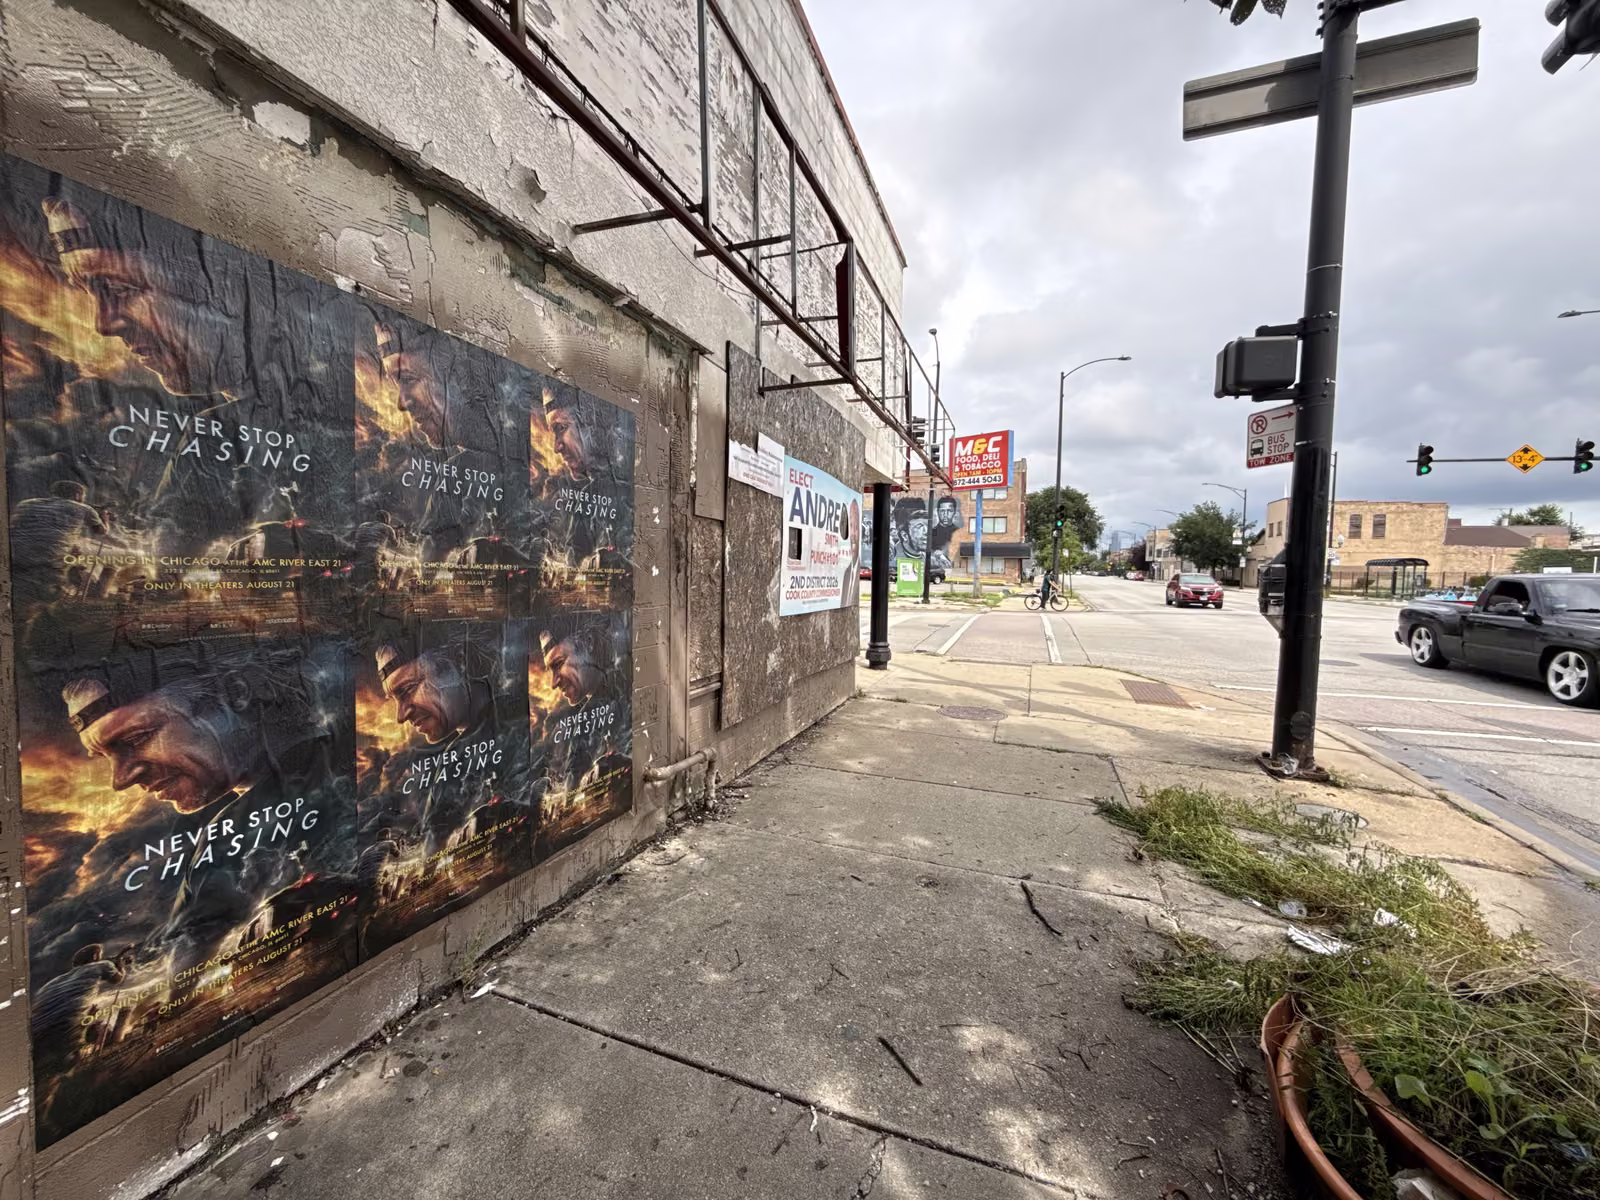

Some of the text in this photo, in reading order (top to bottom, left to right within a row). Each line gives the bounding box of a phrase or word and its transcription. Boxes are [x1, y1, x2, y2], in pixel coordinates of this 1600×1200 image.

[129, 404, 295, 448] NEVER STOP
[108, 426, 310, 472] CHASING
[955, 436, 1002, 457] M&C
[1268, 434, 1285, 445] BUS
[1268, 442, 1289, 454] STOP
[962, 460, 1001, 470] TOBACCO
[983, 453, 1000, 461] DELI
[1270, 454, 1292, 464] ZONE
[411, 457, 496, 484] NEVER STOP
[790, 468, 814, 489] ELECT
[982, 475, 1002, 483] 5043
[402, 472, 504, 501] CHASING
[562, 488, 612, 506] NEVER STOP
[555, 498, 616, 519] CHASING
[789, 486, 841, 533] ANDRE
[63, 554, 136, 565] OPENING
[141, 556, 155, 565] IN
[160, 556, 220, 566] CHICAGO
[252, 558, 276, 566] AMC
[280, 559, 305, 567] RIVER
[308, 559, 330, 567] EAST
[332, 559, 341, 567] 21
[144, 582, 176, 590] ONLY
[180, 582, 192, 590] IN
[196, 582, 243, 590] THEATERS
[790, 576, 806, 589] 2ND
[806, 576, 826, 588] DISTRICT
[786, 590, 800, 600] COOK
[560, 704, 610, 728] NEVER STOP
[554, 712, 614, 744] CHASING
[412, 740, 494, 774] NEVER STOP
[402, 750, 502, 794] CHASING
[144, 797, 305, 861] NEVER STOP
[124, 810, 319, 892] CHASING
[80, 992, 150, 1026] OPENING
[155, 980, 170, 993] IN
[174, 951, 232, 982] CHICAGO
[246, 940, 258, 948] THE
[262, 924, 286, 942] AMC
[288, 912, 314, 929] RIVER
[316, 901, 337, 916] EAST
[340, 896, 348, 906] 21
[158, 994, 188, 1015] ONLY
[192, 988, 204, 998] IN
[209, 962, 254, 989] THEATERS
[256, 942, 292, 966] AUGUST
[294, 937, 303, 947] 21
